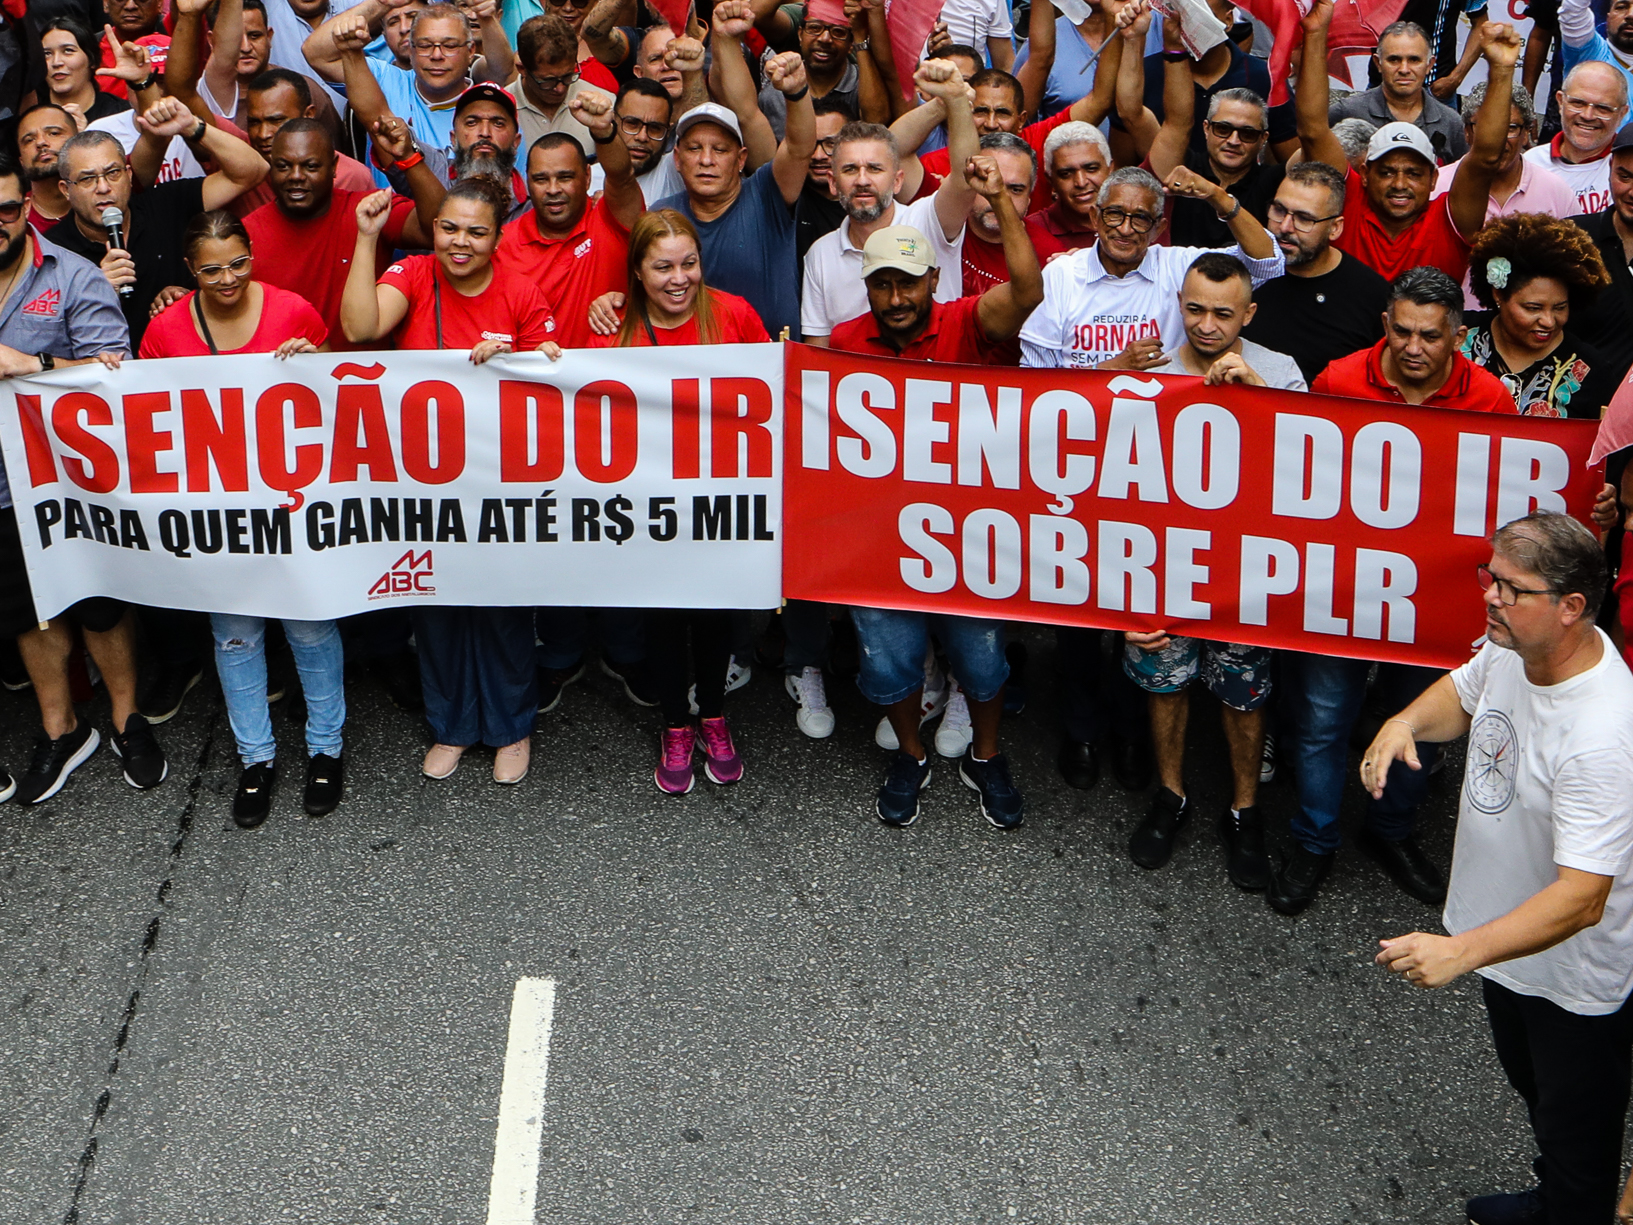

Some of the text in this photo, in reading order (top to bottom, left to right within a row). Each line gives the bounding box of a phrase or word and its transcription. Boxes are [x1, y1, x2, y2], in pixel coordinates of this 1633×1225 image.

[22, 298, 60, 313] ABC
[1093, 313, 1148, 324] REDUZIR A
[1070, 352, 1099, 364] SEM
[15, 361, 773, 514] ISENÇÃO DO IR
[801, 370, 1571, 538] ISENÇÃO DO IR
[34, 489, 775, 559] PARA QUEM GANHA ATÉ R$ 5 MIL
[367, 570, 436, 596] ABC
[897, 502, 1419, 645] SOBRE PLR
[367, 593, 391, 601] SINDICATO
